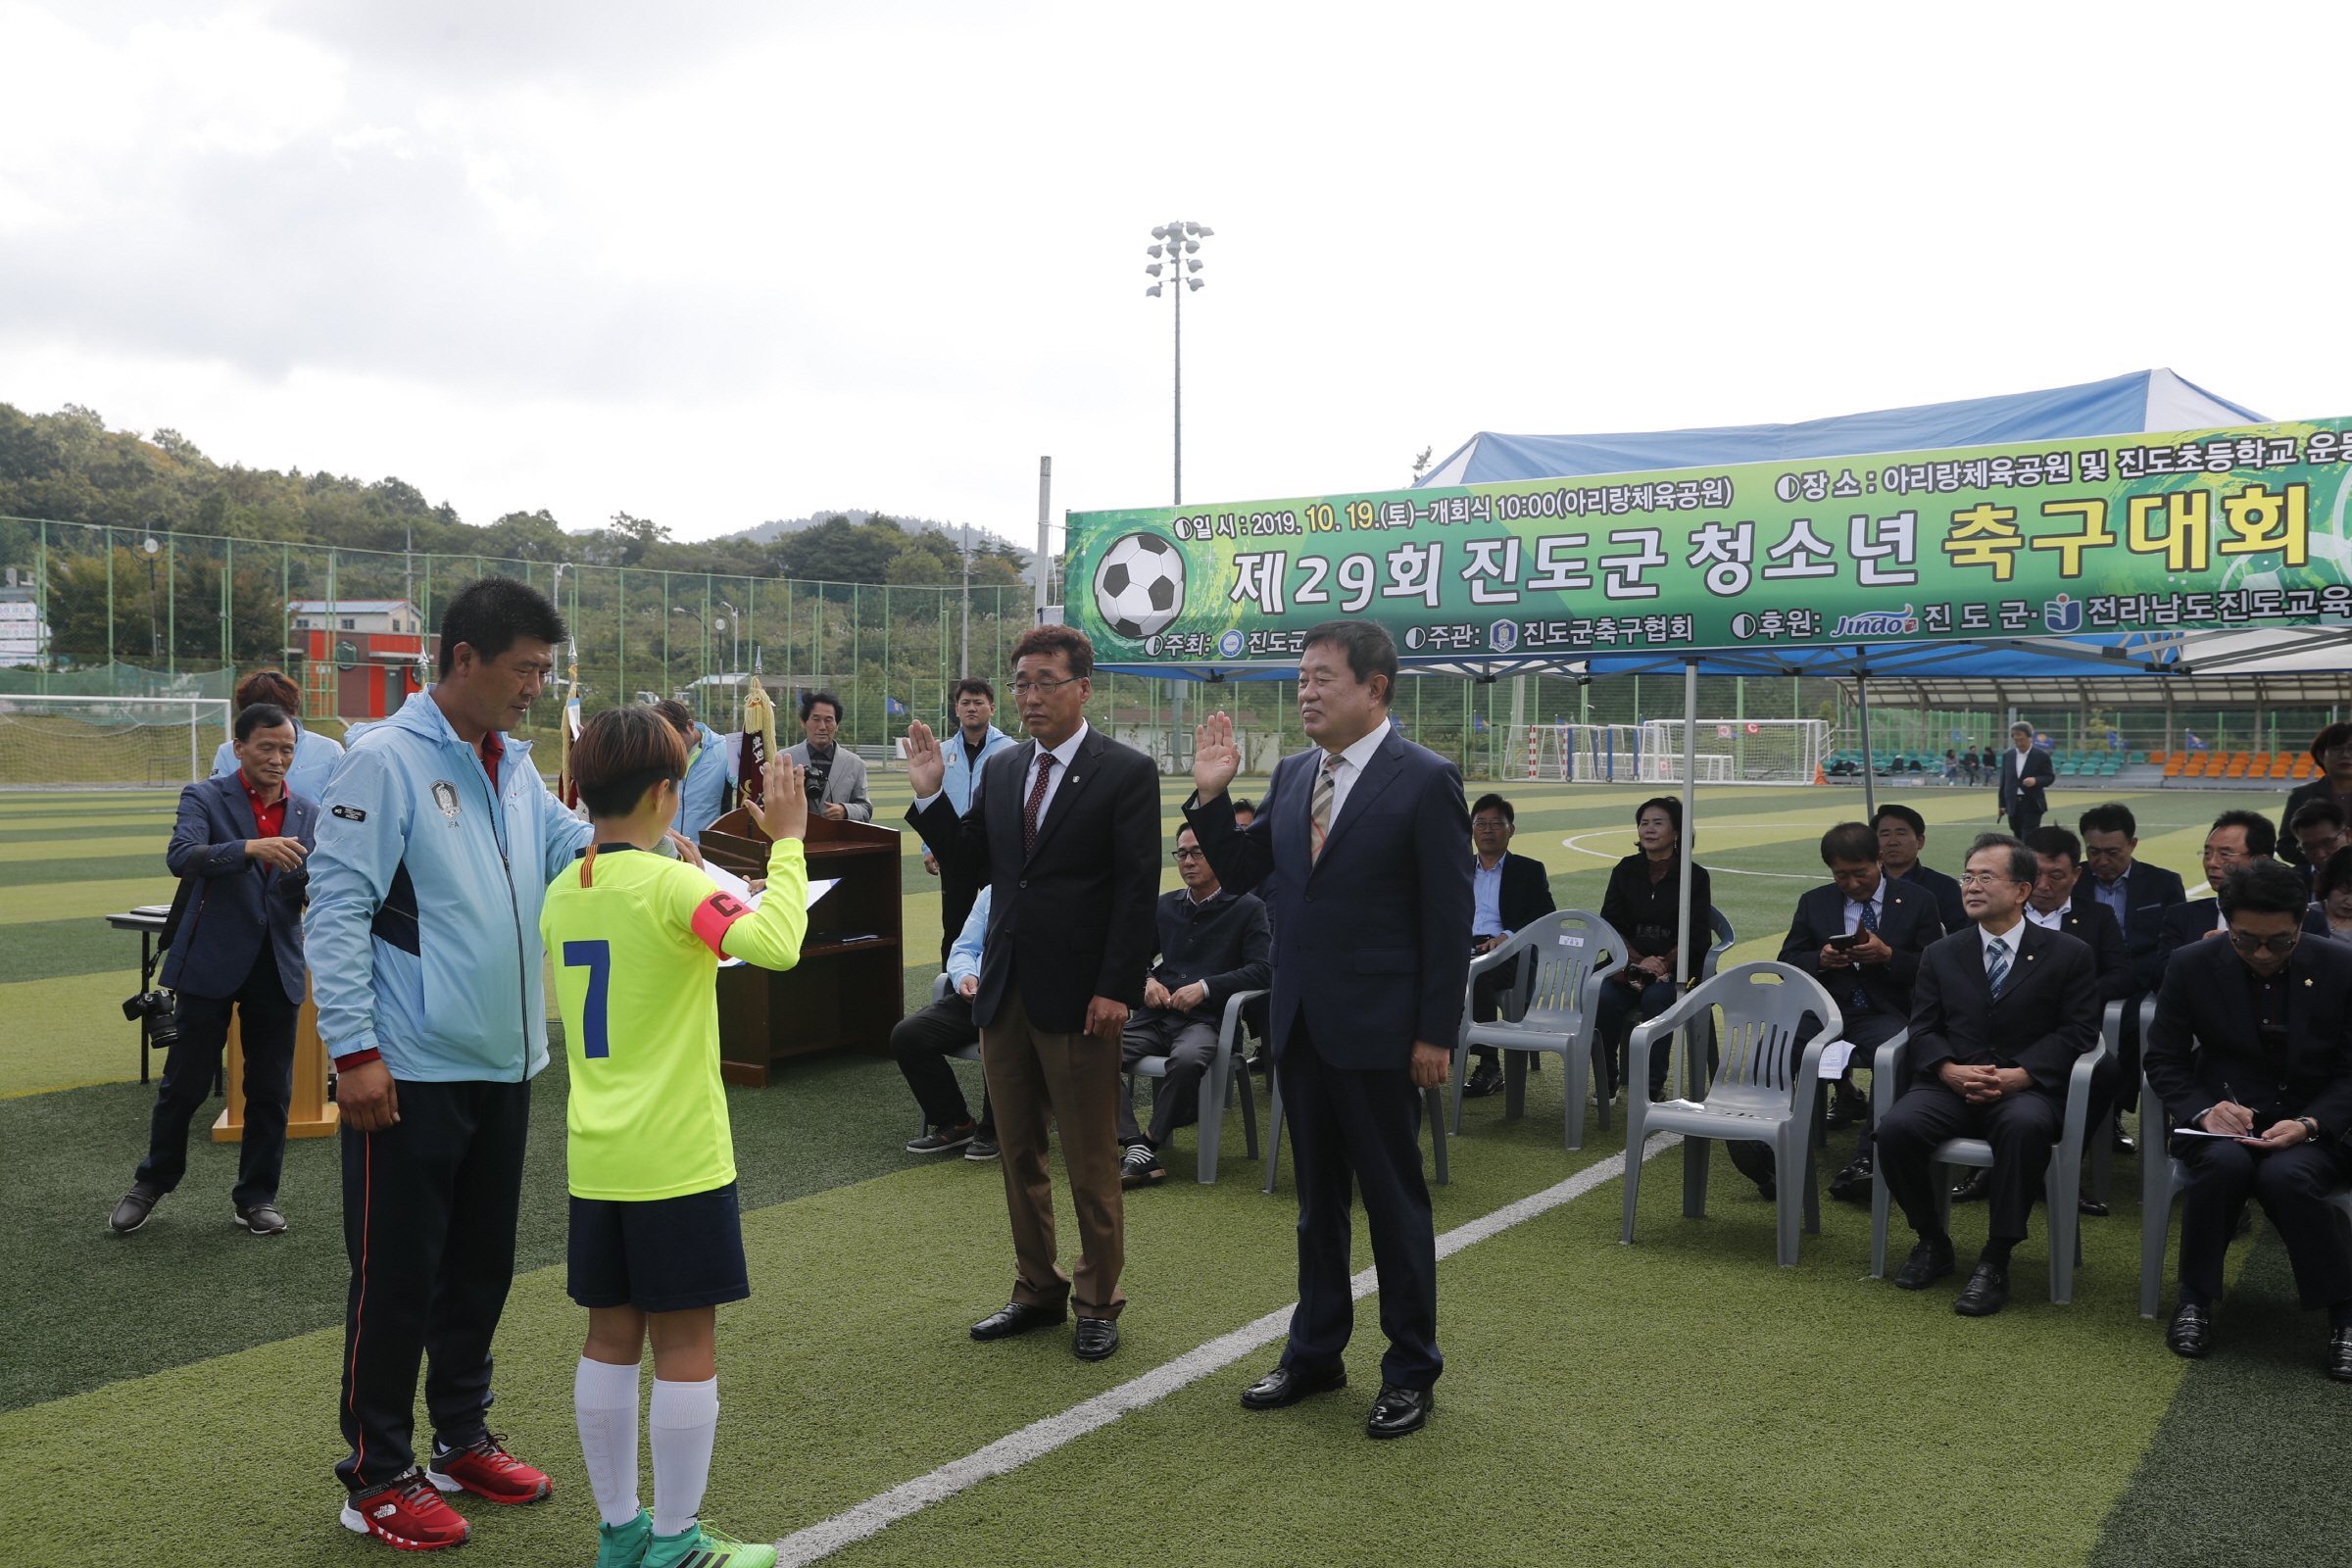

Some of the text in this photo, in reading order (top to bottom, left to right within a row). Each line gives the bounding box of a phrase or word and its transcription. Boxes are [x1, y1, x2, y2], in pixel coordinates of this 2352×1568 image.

[1251, 511, 1301, 535] 2019.
[1307, 505, 1341, 532] 10.
[1885, 453, 2071, 493] 아리랑체육공원
[2080, 450, 2107, 479] 및
[2118, 437, 2297, 478] 진도초등학교
[1229, 483, 2309, 614] 제29회 진도군 청소년 축구대회
[1163, 632, 1210, 657] 주최:
[1428, 623, 1481, 650] 주관:
[1522, 615, 1693, 647] 진도군축구협회
[1757, 610, 1821, 638] 후원:
[1831, 616, 1903, 637] Jindo
[2087, 586, 2352, 624] 전라남도진도교육
[710, 894, 743, 917] C
[563, 939, 611, 1058] 7
